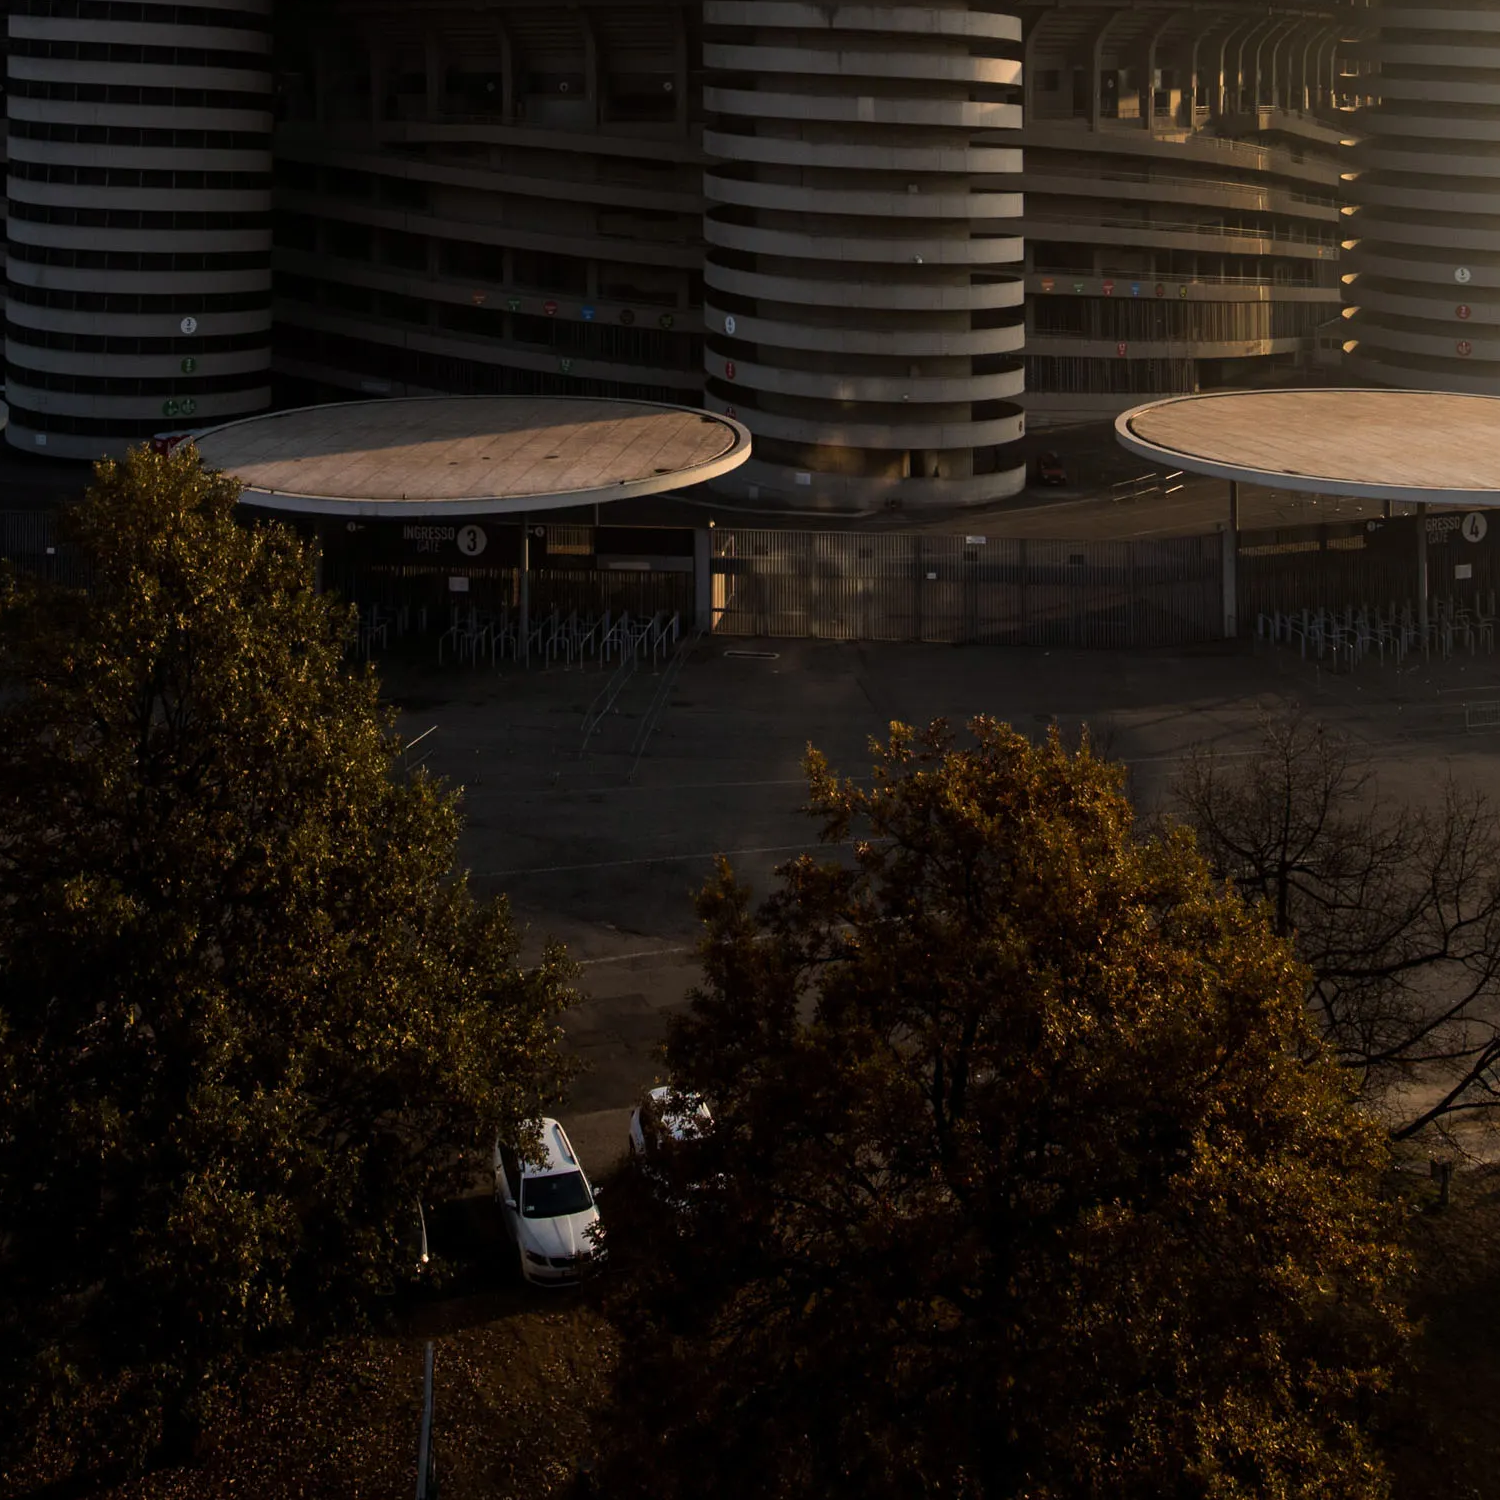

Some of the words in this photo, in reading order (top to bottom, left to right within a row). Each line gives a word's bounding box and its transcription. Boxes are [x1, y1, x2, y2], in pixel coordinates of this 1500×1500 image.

[403, 524, 455, 541] INGRESSO
[467, 529, 478, 552] 3
[1425, 515, 1461, 532] GRESSO
[1469, 515, 1479, 538] 4
[416, 539, 441, 553] GATE
